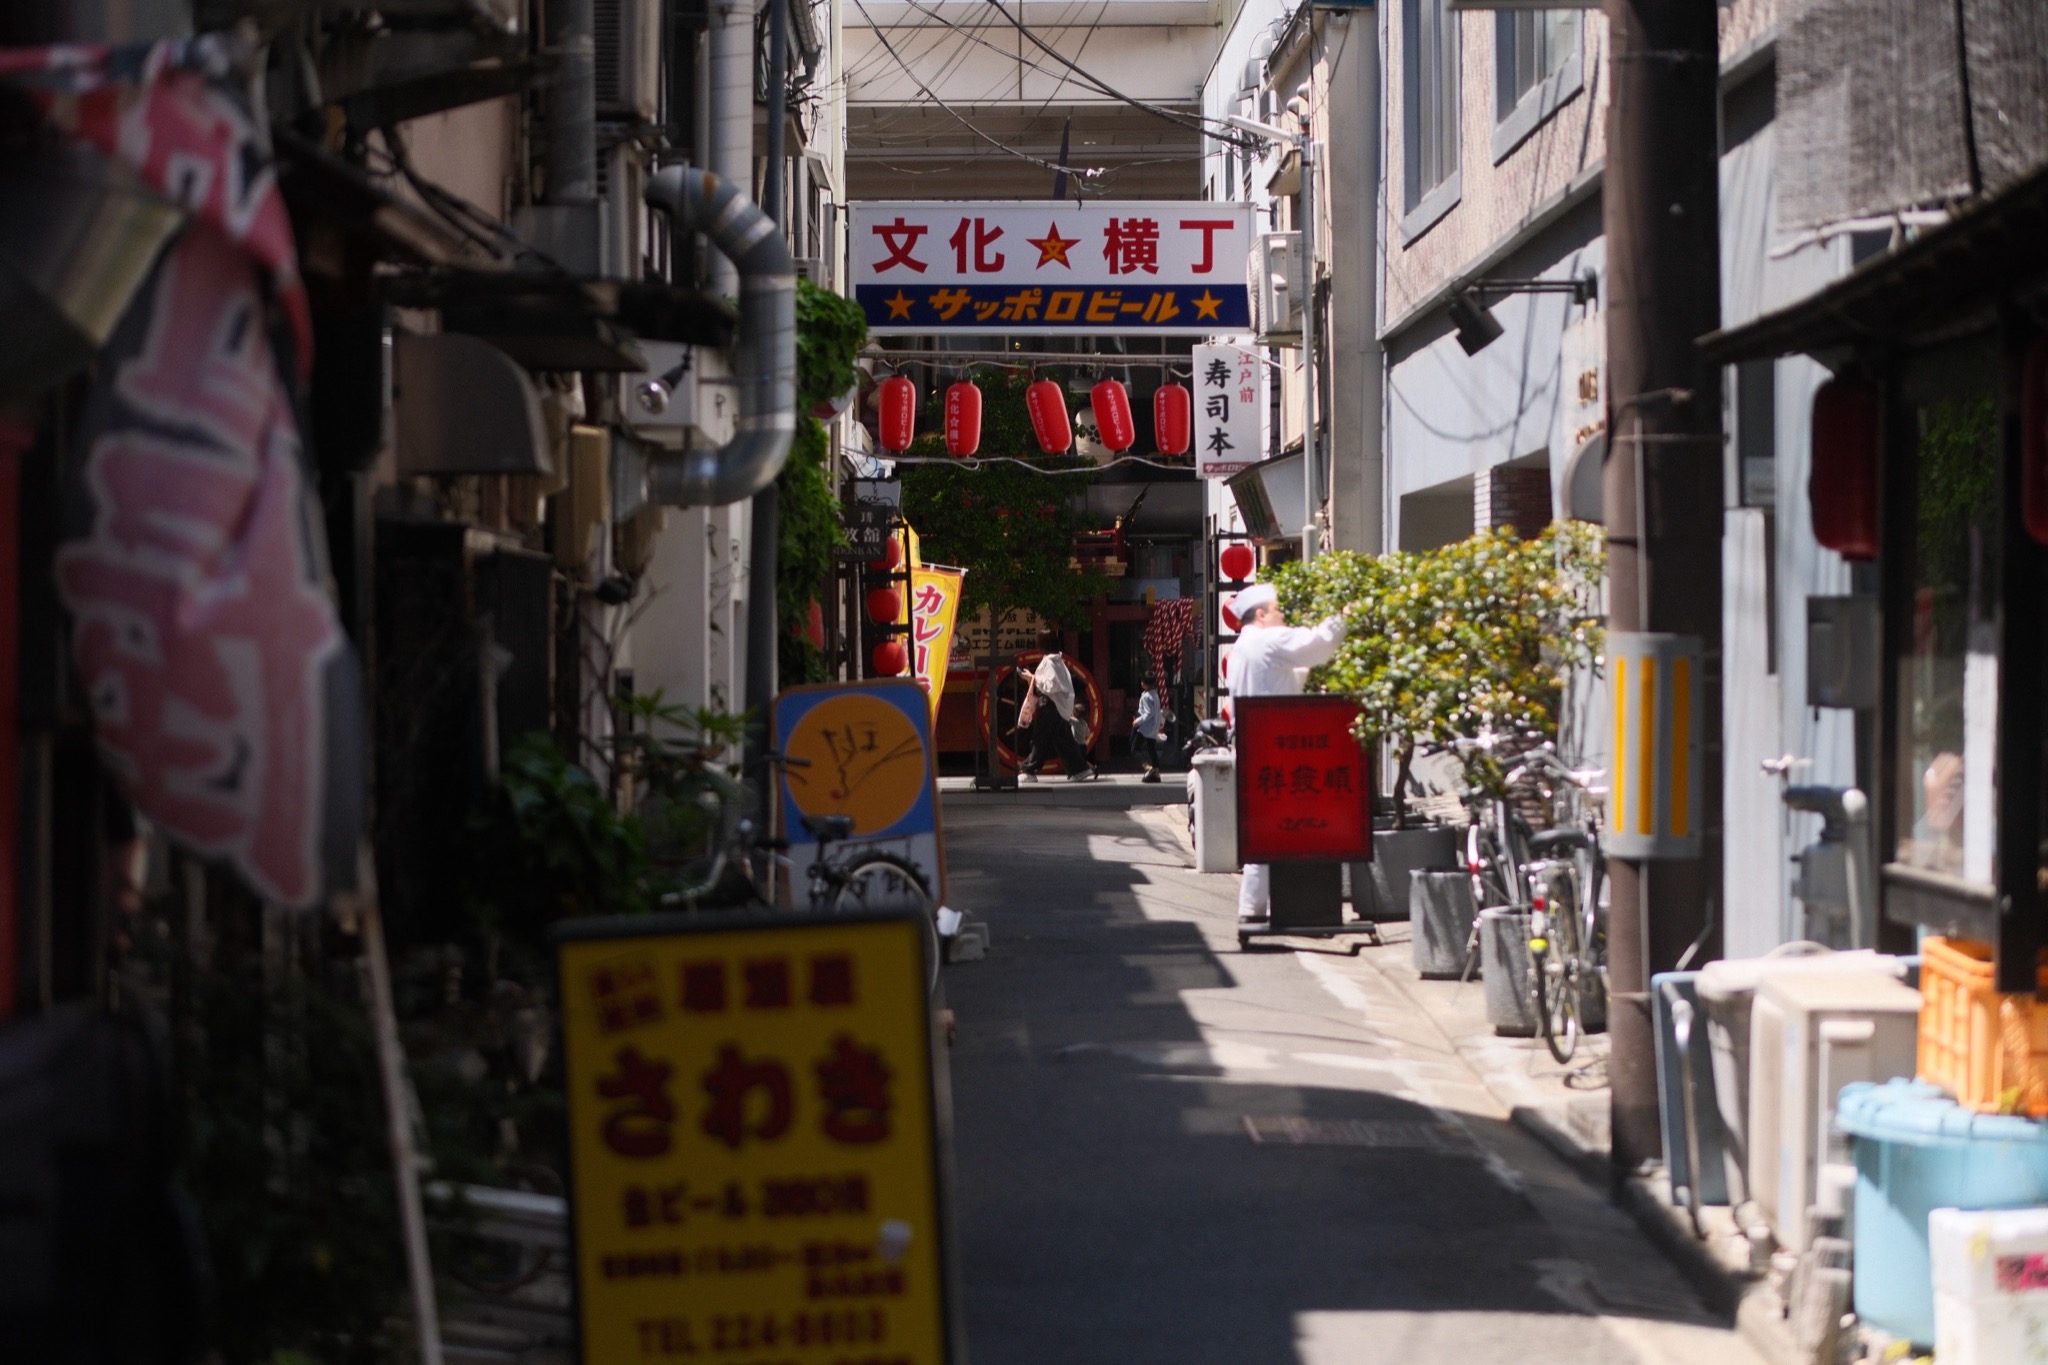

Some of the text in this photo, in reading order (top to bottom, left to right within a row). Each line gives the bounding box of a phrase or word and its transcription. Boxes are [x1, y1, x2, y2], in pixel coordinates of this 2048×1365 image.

[871, 217, 1005, 275] 文化
[1102, 217, 1235, 275] 横丁
[928, 287, 1181, 324] サッポロビール
[1238, 350, 1255, 403] 江戸前
[1204, 358, 1236, 457] 寿司本
